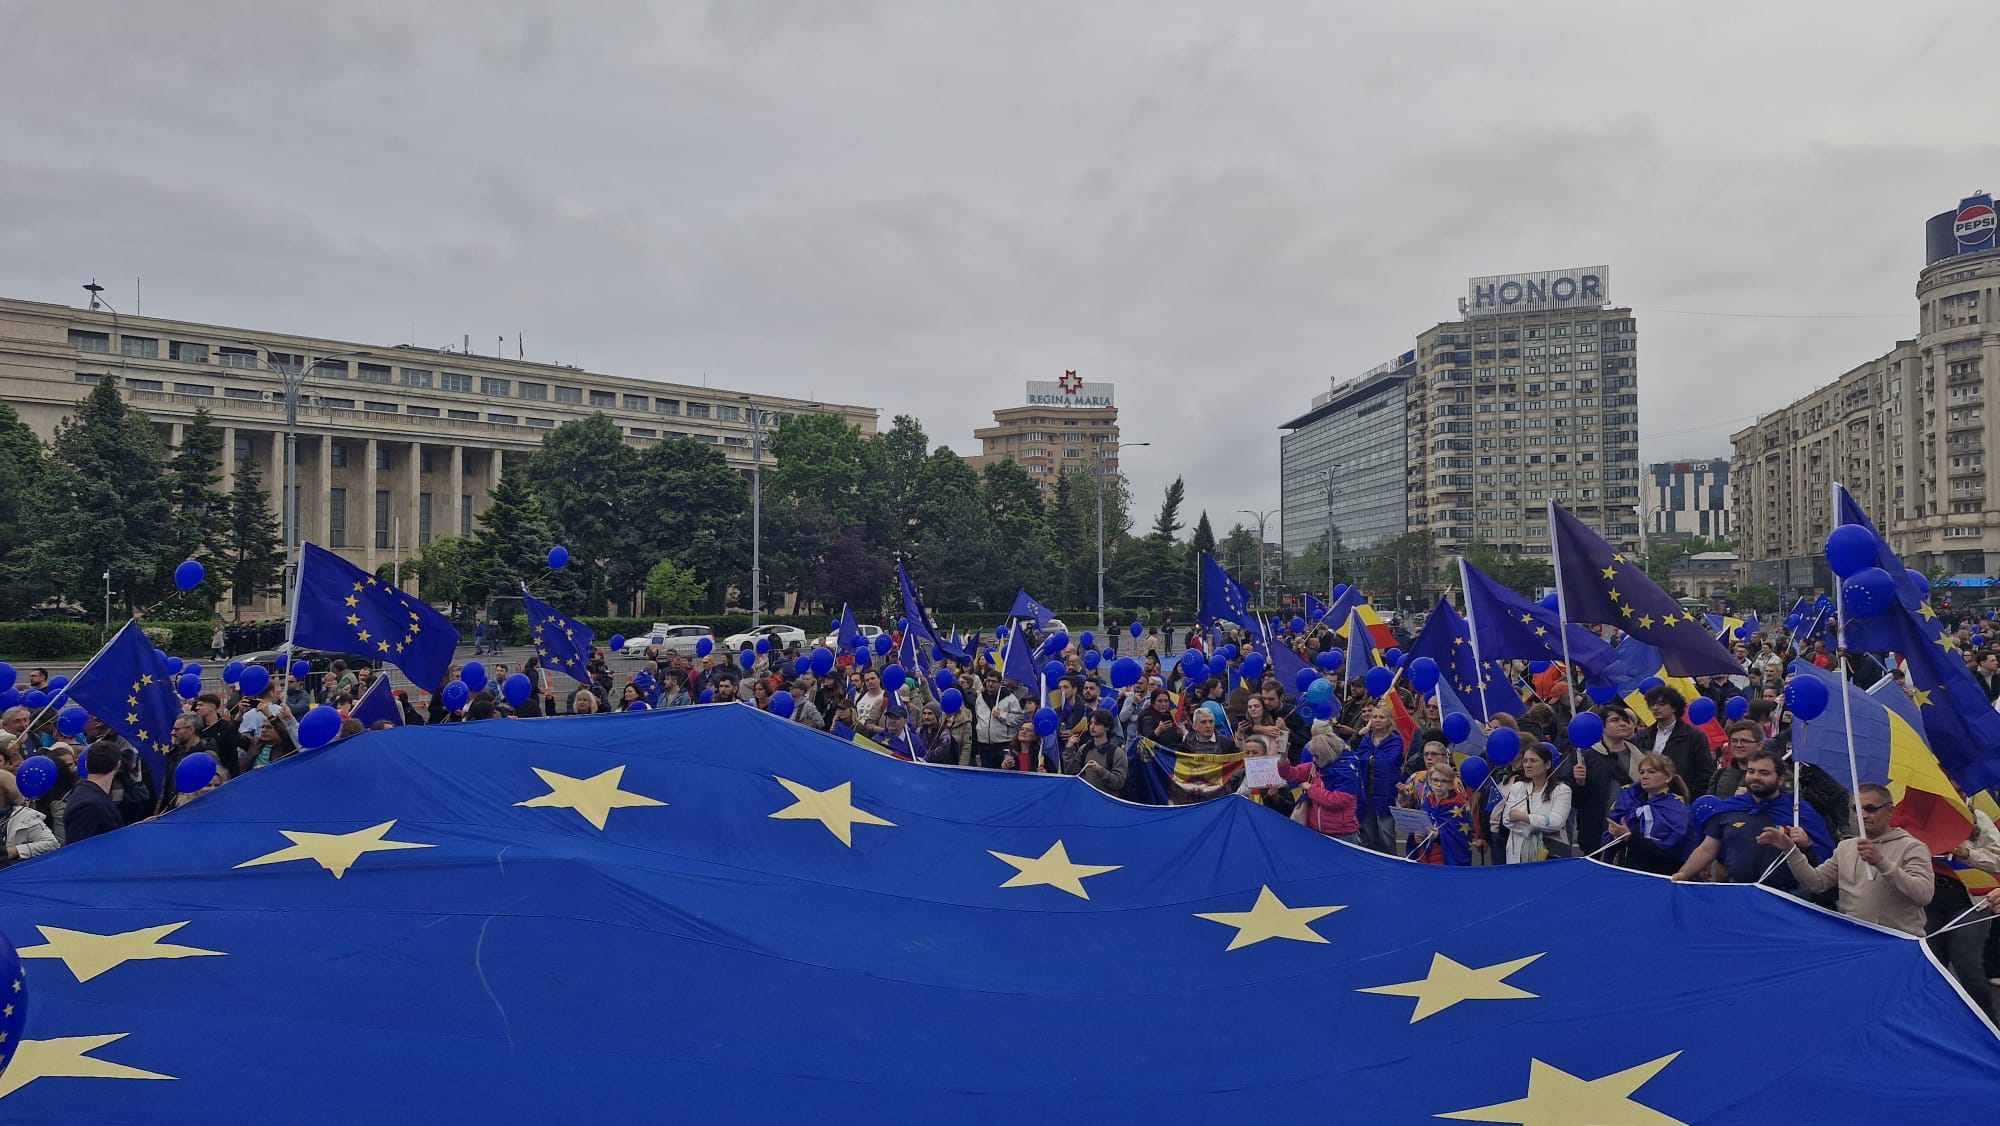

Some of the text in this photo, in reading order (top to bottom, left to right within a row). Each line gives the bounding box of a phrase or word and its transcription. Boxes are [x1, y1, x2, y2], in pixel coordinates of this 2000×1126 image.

[1956, 217, 1994, 232] PEPSI
[1475, 274, 1602, 307] HONOR
[1029, 394, 1110, 405] REGINA MARIA
